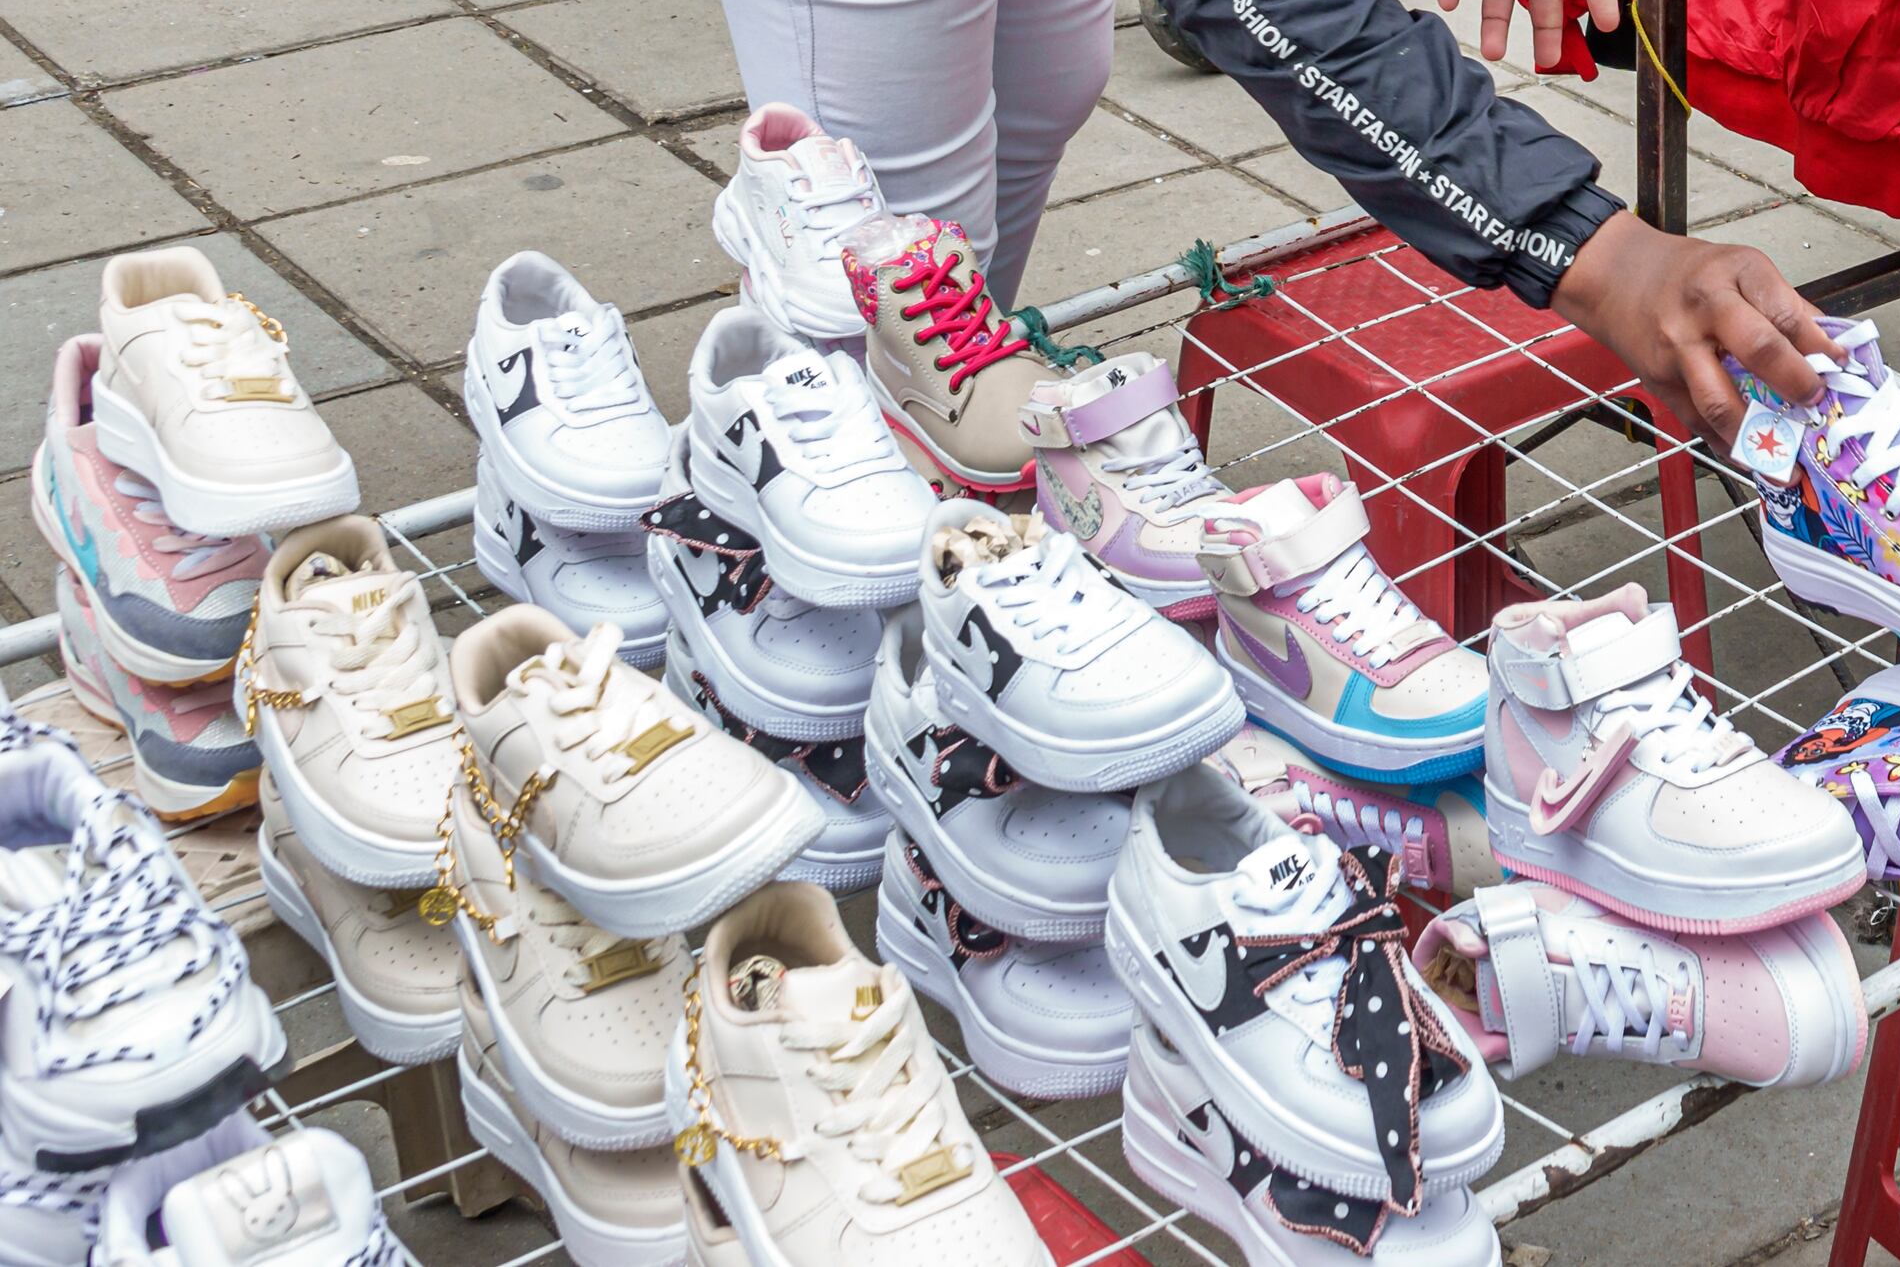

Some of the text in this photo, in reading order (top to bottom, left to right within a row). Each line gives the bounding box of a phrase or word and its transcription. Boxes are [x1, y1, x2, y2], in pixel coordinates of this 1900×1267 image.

[1299, 65, 1360, 121] STAR
[1429, 174, 1489, 232] STAR
[784, 366, 815, 385] NIKE
[1269, 853, 1302, 886] NIKE
